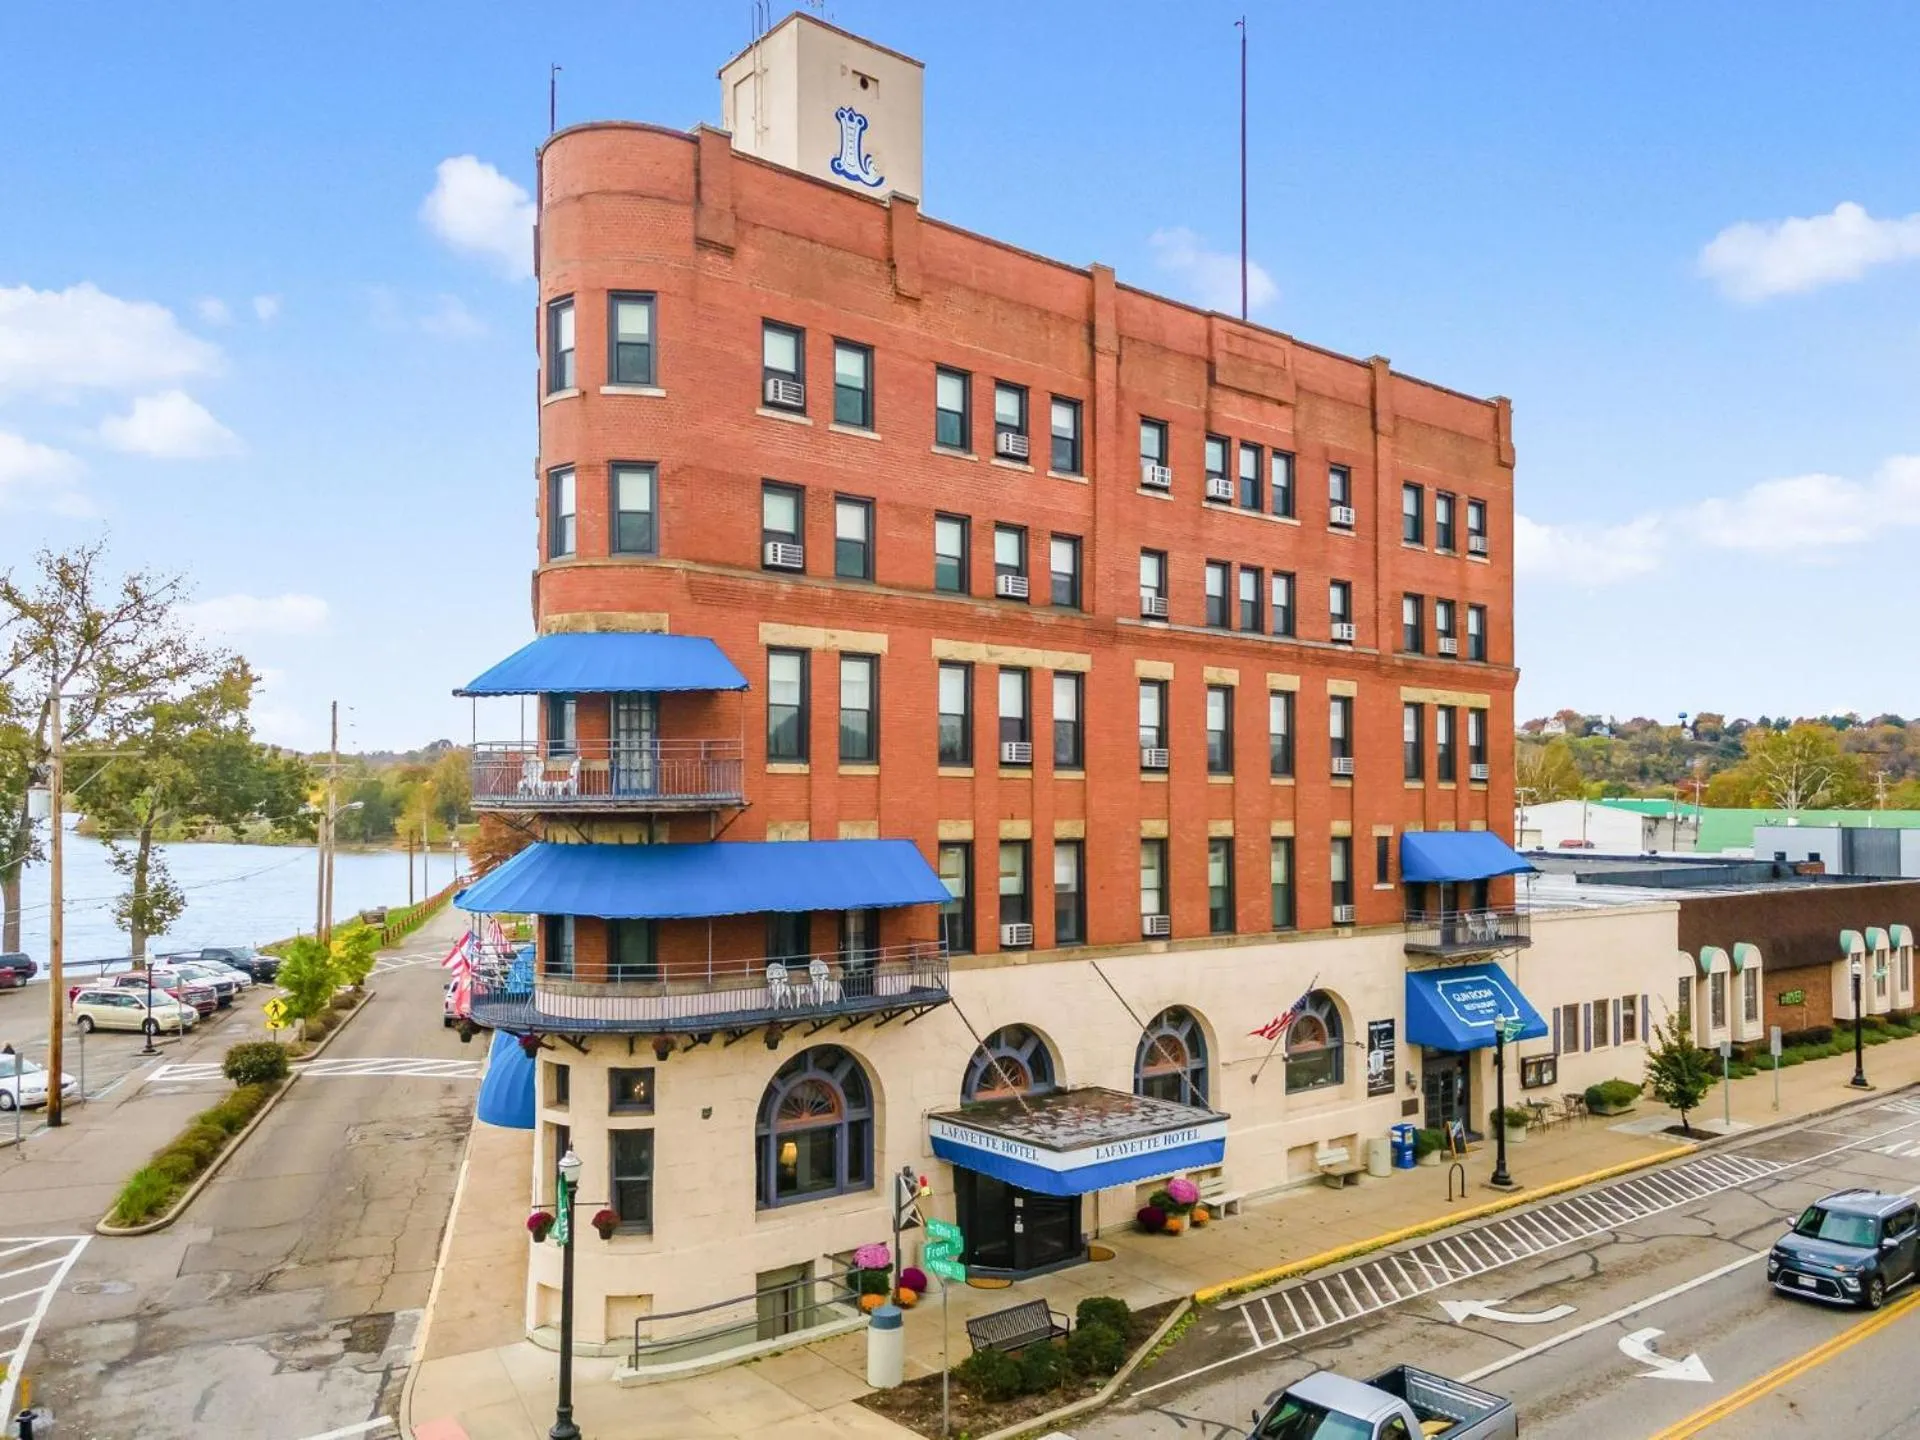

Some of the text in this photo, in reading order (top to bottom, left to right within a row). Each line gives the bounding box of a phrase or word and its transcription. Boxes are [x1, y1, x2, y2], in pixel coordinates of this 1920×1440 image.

[941, 1124, 1039, 1161] LAFAYETTE HOTEL
[1096, 1129, 1200, 1160] LAFAYETTE HOTEL
[926, 1243, 949, 1259] Front
